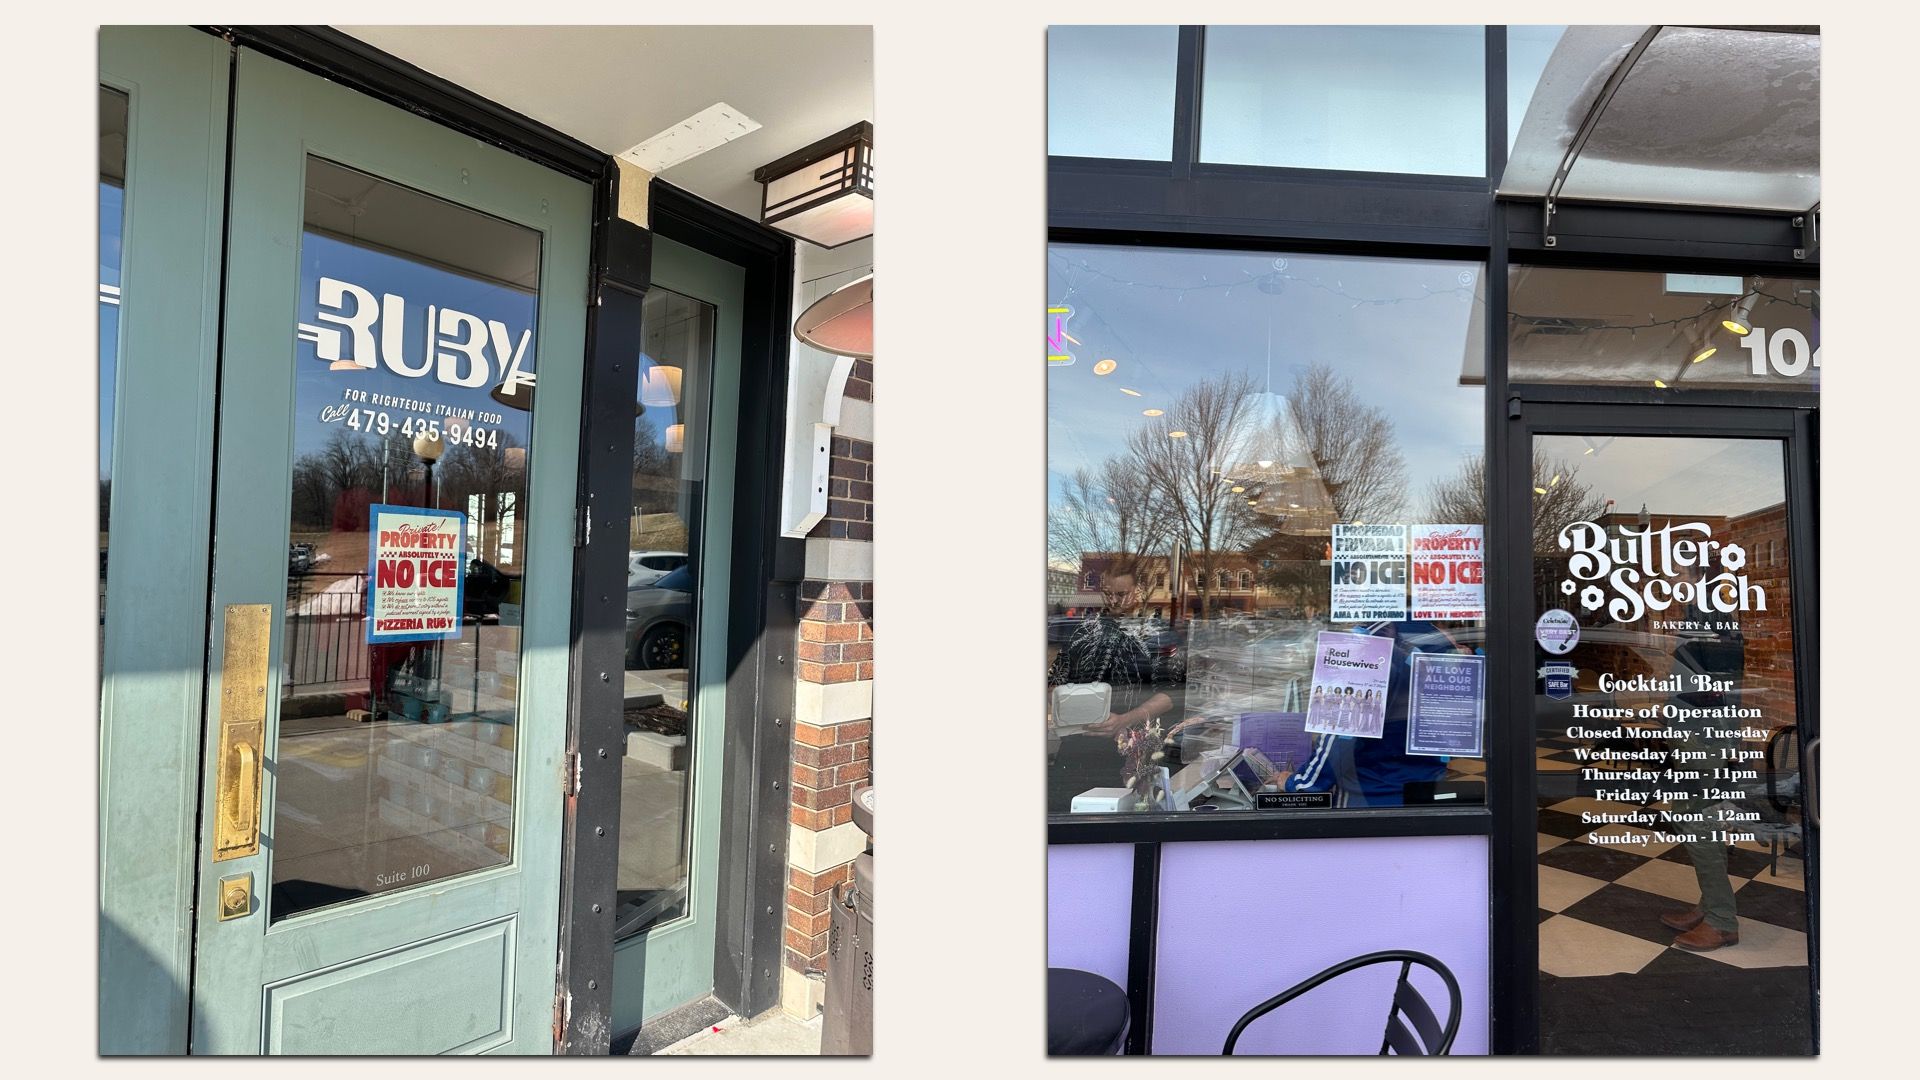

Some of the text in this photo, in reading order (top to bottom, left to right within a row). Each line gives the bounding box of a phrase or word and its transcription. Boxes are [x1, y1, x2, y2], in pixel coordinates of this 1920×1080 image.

[298, 277, 536, 396] RUBY
[1741, 327, 1820, 377] 10
[321, 403, 350, 424] Call
[345, 388, 502, 425] FOR RIGHTEOUS ITALIAN FOOD
[347, 408, 498, 450] 479-435-9494
[380, 530, 457, 549] PROPERTY
[1413, 537, 1482, 551] PROPERTY
[398, 551, 439, 559] ABSOLUTELY
[1557, 519, 1722, 581] Butter
[377, 560, 457, 589] NO ICE
[1334, 561, 1405, 585] NO ICE
[1413, 561, 1483, 585] NO ICE
[1608, 567, 1767, 623] Scotch
[1333, 610, 1352, 619] AMA
[1354, 610, 1361, 619] A
[1362, 610, 1371, 619] TU
[1413, 610, 1432, 619] LOVE
[1434, 610, 1448, 619] THY
[376, 617, 454, 631] PIZZERIA RUBY
[1653, 620, 1740, 631] BAKERY & BAR
[1329, 648, 1350, 658] Real
[1323, 656, 1379, 670] Housewives
[1425, 665, 1472, 675] WE LOVE
[1424, 683, 1471, 692] NEIGHBORS
[1425, 675, 1472, 685] ALL OUR
[1598, 673, 1734, 694] Cocktail Bar
[1572, 703, 1762, 723] Hours of Operation
[1566, 726, 1623, 740] Closed
[1625, 726, 1691, 743] Monday
[1703, 726, 1770, 743] Tuesday
[1573, 748, 1668, 765] Wednesday
[1671, 748, 1706, 765] 4pm
[1719, 747, 1765, 764] 11pm
[1582, 768, 1661, 785] Thursday
[1663, 768, 1699, 784] 4pm
[1713, 767, 1758, 784] 11pm
[1595, 788, 1650, 805] Friday
[1652, 788, 1688, 804] 4pm
[1701, 787, 1746, 801] 12am
[1581, 810, 1656, 827] Saturday
[1660, 810, 1704, 823] Noon
[1716, 809, 1761, 823] 12am
[1588, 832, 1650, 848] Sunday
[1653, 831, 1698, 845] Noon
[1709, 830, 1756, 847] 11pm
[376, 863, 431, 888] Suite 100
